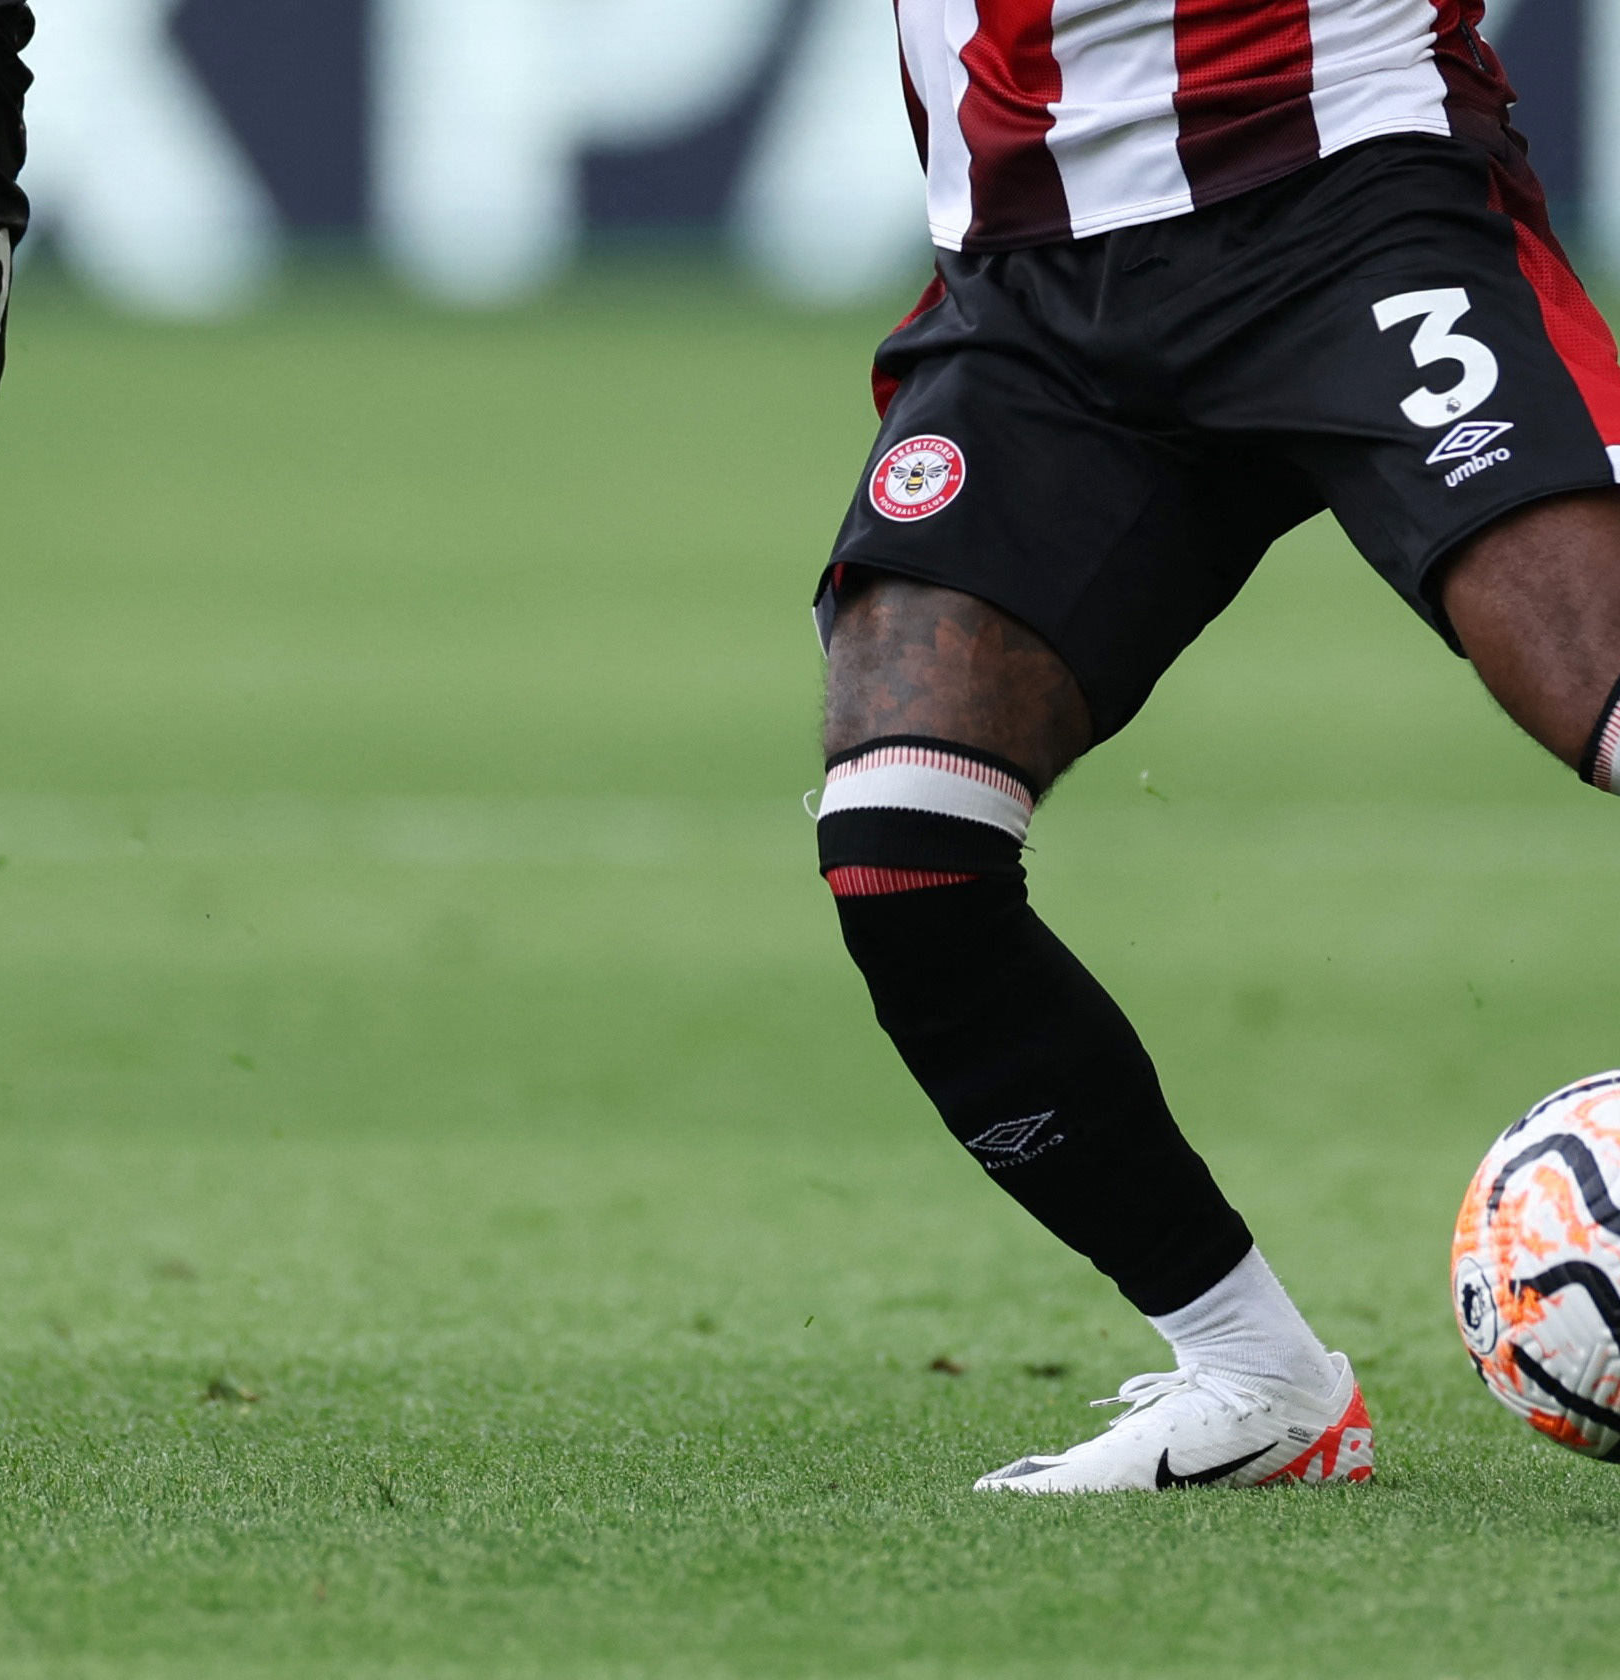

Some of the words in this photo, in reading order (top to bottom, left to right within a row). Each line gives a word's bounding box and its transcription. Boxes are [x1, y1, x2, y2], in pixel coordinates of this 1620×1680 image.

[1372, 287, 1499, 429] 3
[890, 441, 955, 463] BRENTFORD
[1444, 447, 1511, 488] umbro
[878, 496, 918, 515] FOOTBALL
[921, 495, 946, 512] CLUB
